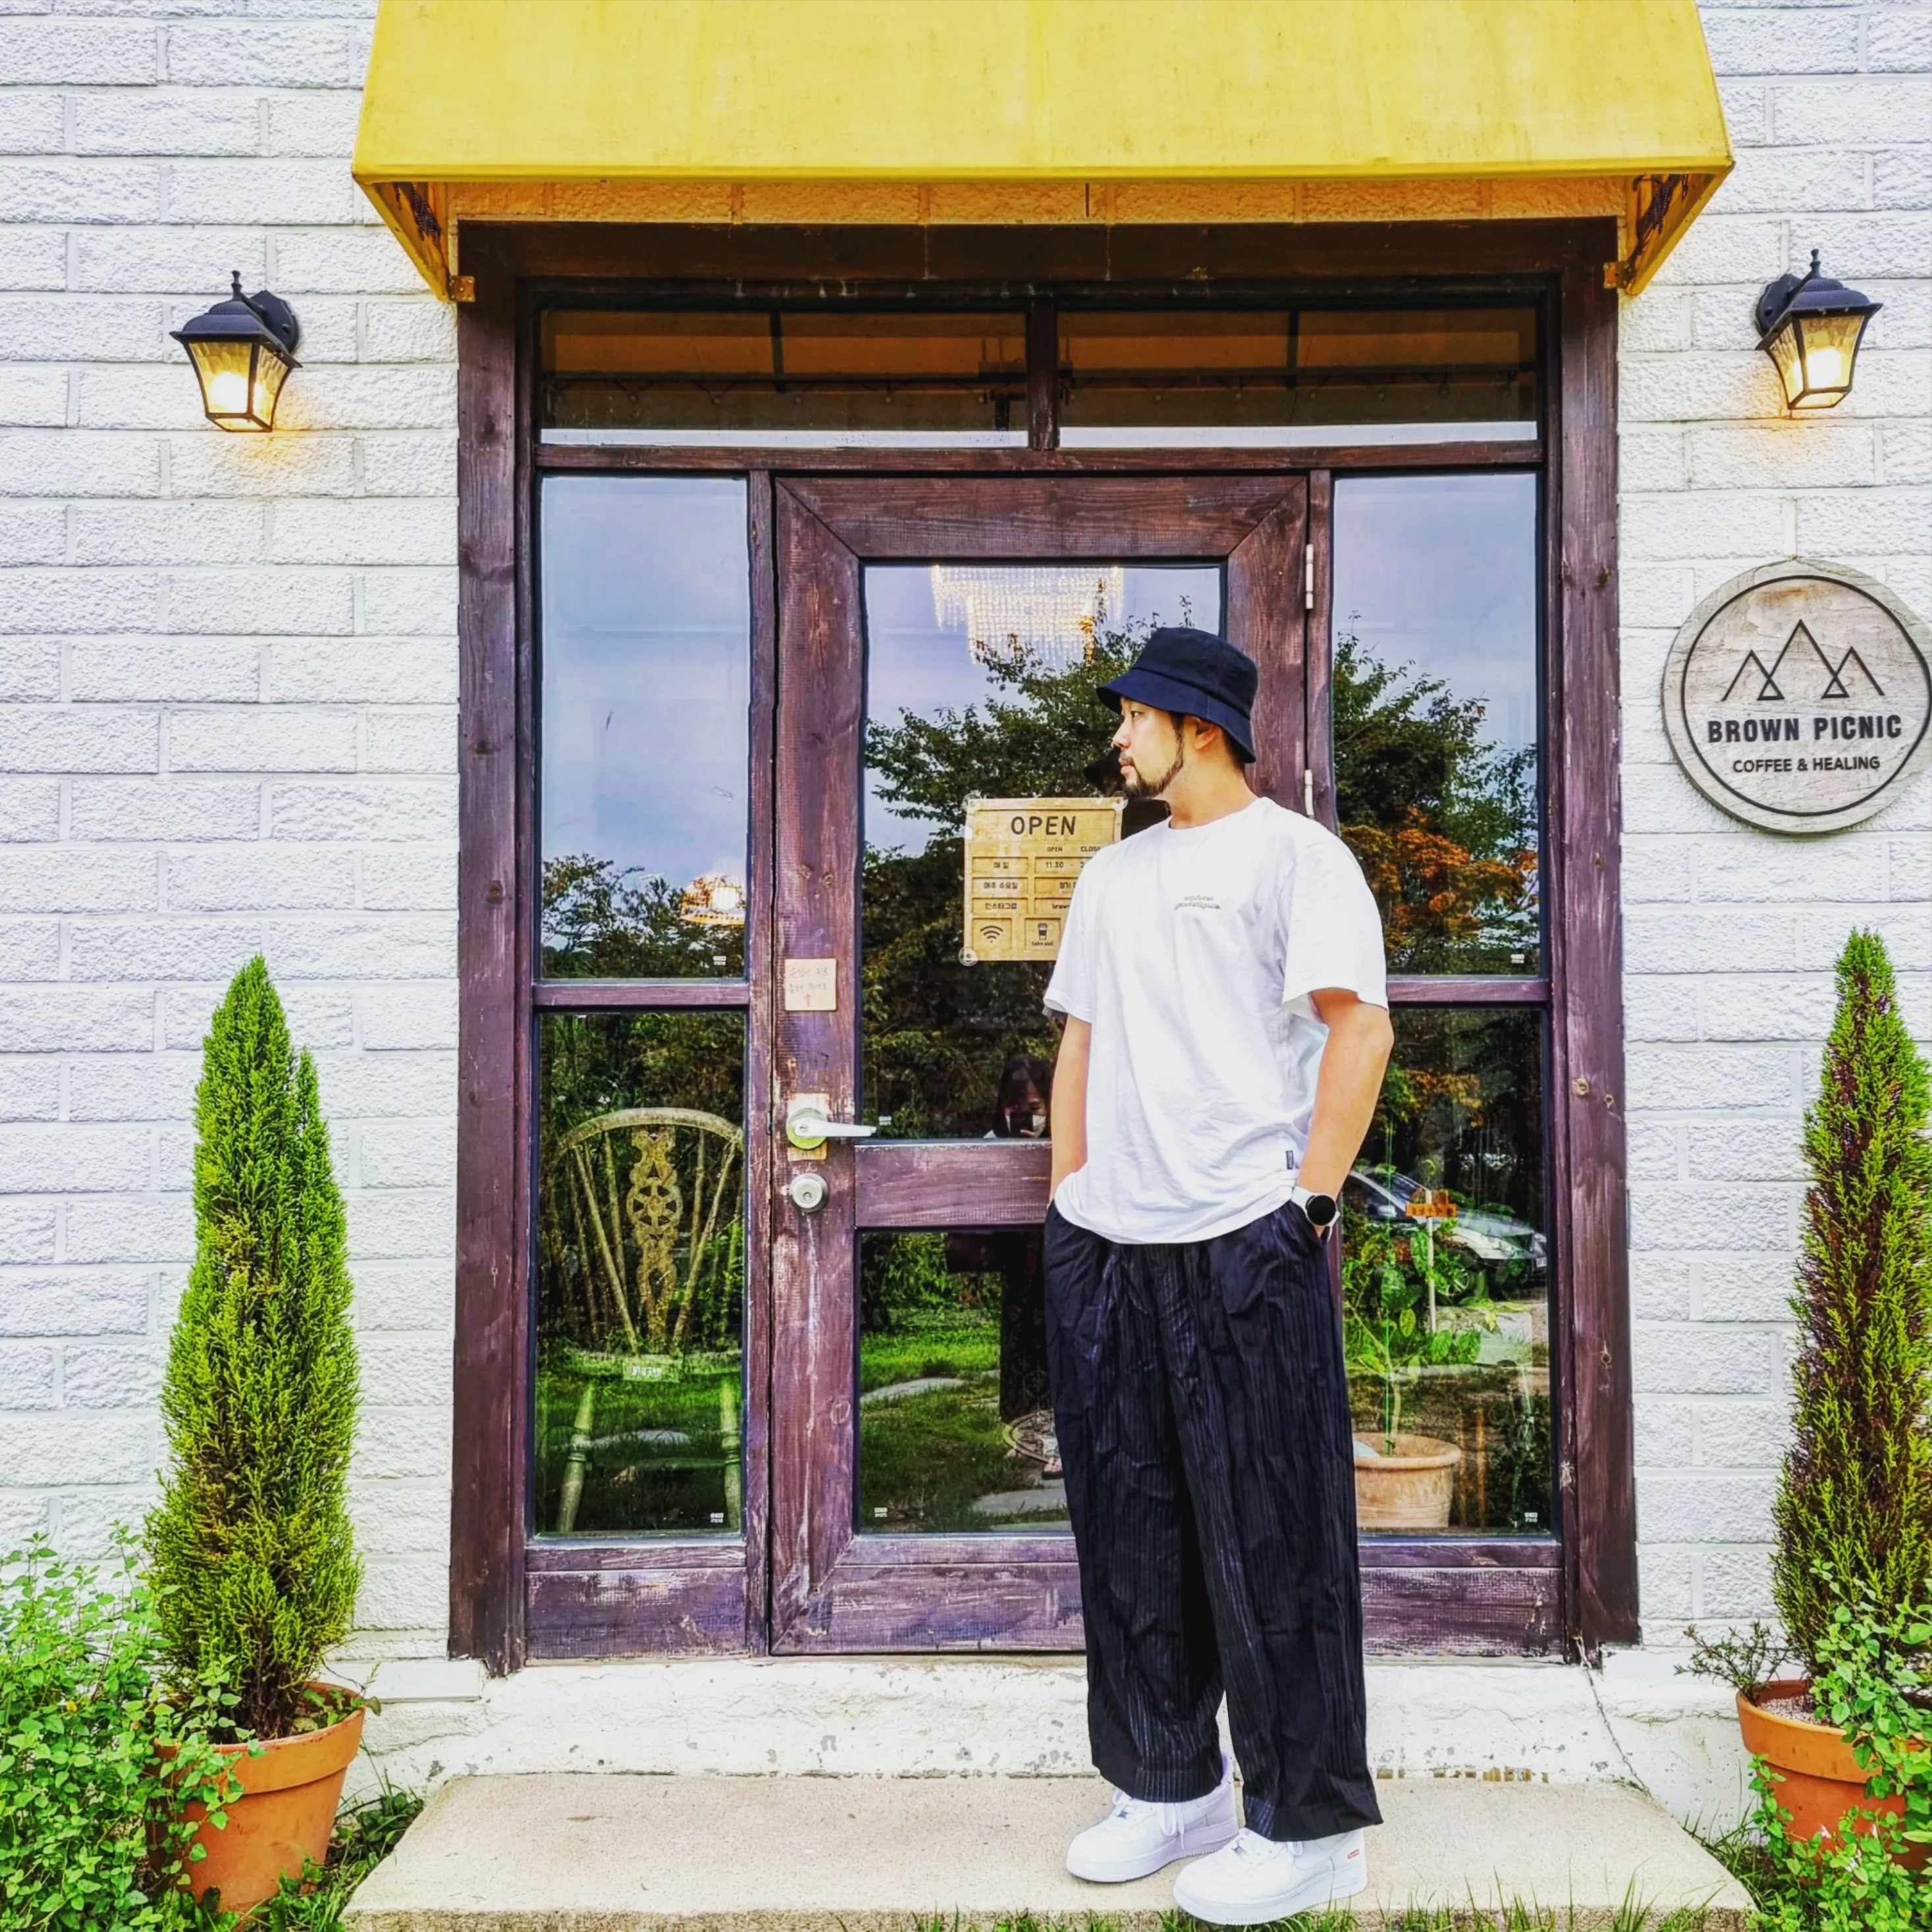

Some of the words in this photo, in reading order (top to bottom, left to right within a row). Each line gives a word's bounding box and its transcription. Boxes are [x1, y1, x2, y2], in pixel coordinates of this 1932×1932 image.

[1708, 718, 1799, 743] BROWN
[1814, 714, 1902, 740] PICNIC
[1732, 759, 1792, 773] COFFEE
[1797, 758, 1808, 772] &
[1813, 756, 1881, 771] HEALING
[1011, 816, 1077, 836] OPEN
